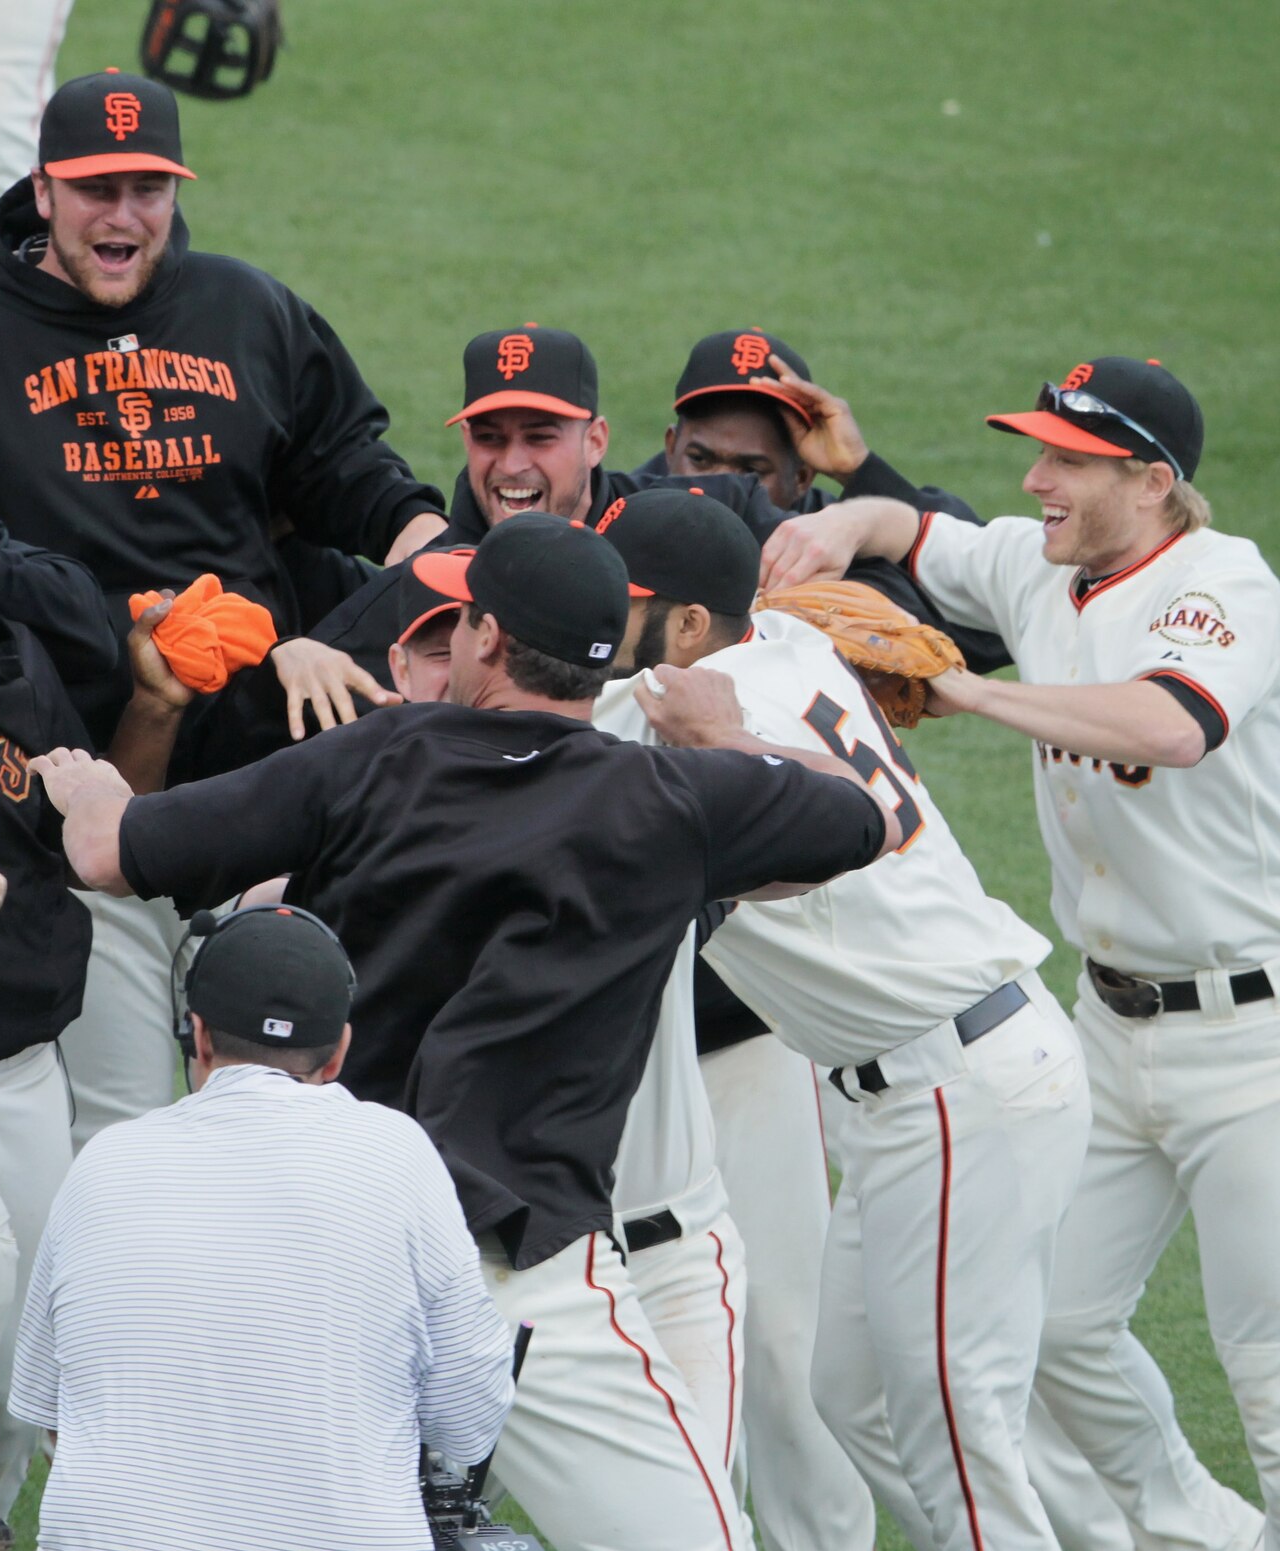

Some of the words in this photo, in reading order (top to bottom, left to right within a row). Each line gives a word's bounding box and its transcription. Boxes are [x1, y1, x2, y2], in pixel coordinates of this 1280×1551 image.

[104, 92, 142, 141] SF
[496, 334, 535, 381] SF
[730, 334, 770, 376] SF
[24, 357, 80, 415] SAN
[83, 348, 238, 402] FRANCISCO
[76, 411, 110, 426] EST.
[116, 391, 153, 439] SF
[163, 405, 196, 422] 1958
[62, 434, 221, 473] BASEBALL
[103, 471, 153, 482] AUTHENTIC
[156, 467, 204, 479] COLLECTION
[1148, 608, 1236, 649] GIANTS
